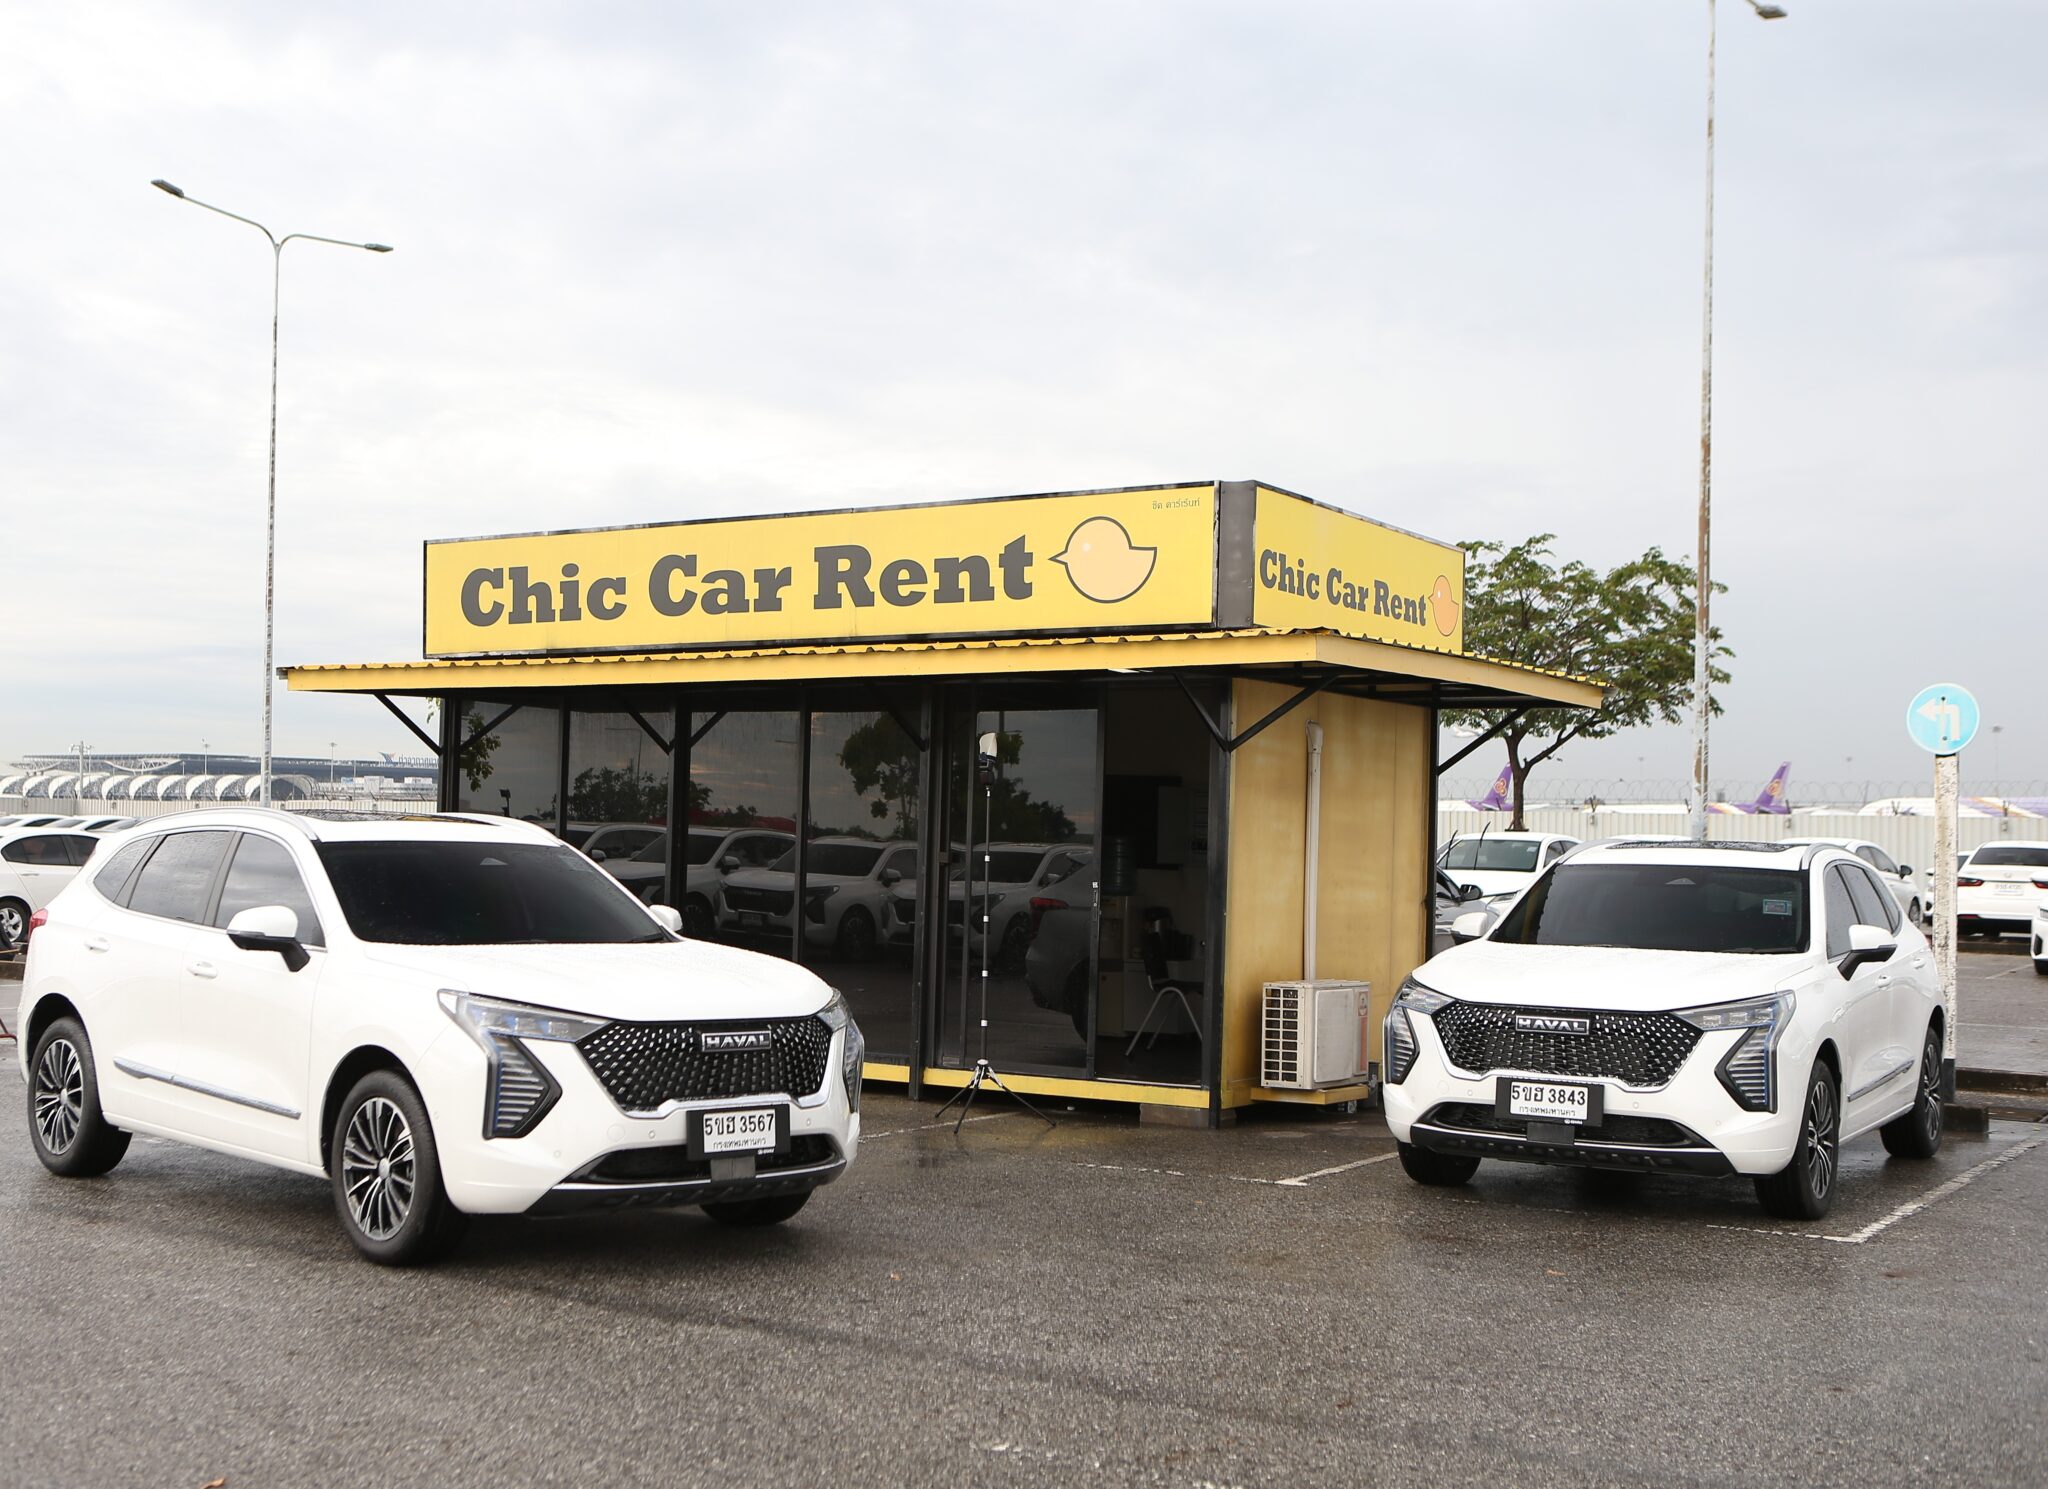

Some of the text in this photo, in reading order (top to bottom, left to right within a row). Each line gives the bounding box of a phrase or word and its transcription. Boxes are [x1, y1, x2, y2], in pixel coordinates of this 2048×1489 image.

[461, 534, 1034, 627] Chic Car Rent
[1259, 548, 1427, 627] Chic Car Rent
[1518, 1018, 1585, 1032] HAVAL
[706, 1034, 769, 1048] HAVAL
[1548, 1088, 1586, 1106] 3843
[740, 1113, 774, 1133] 3567
